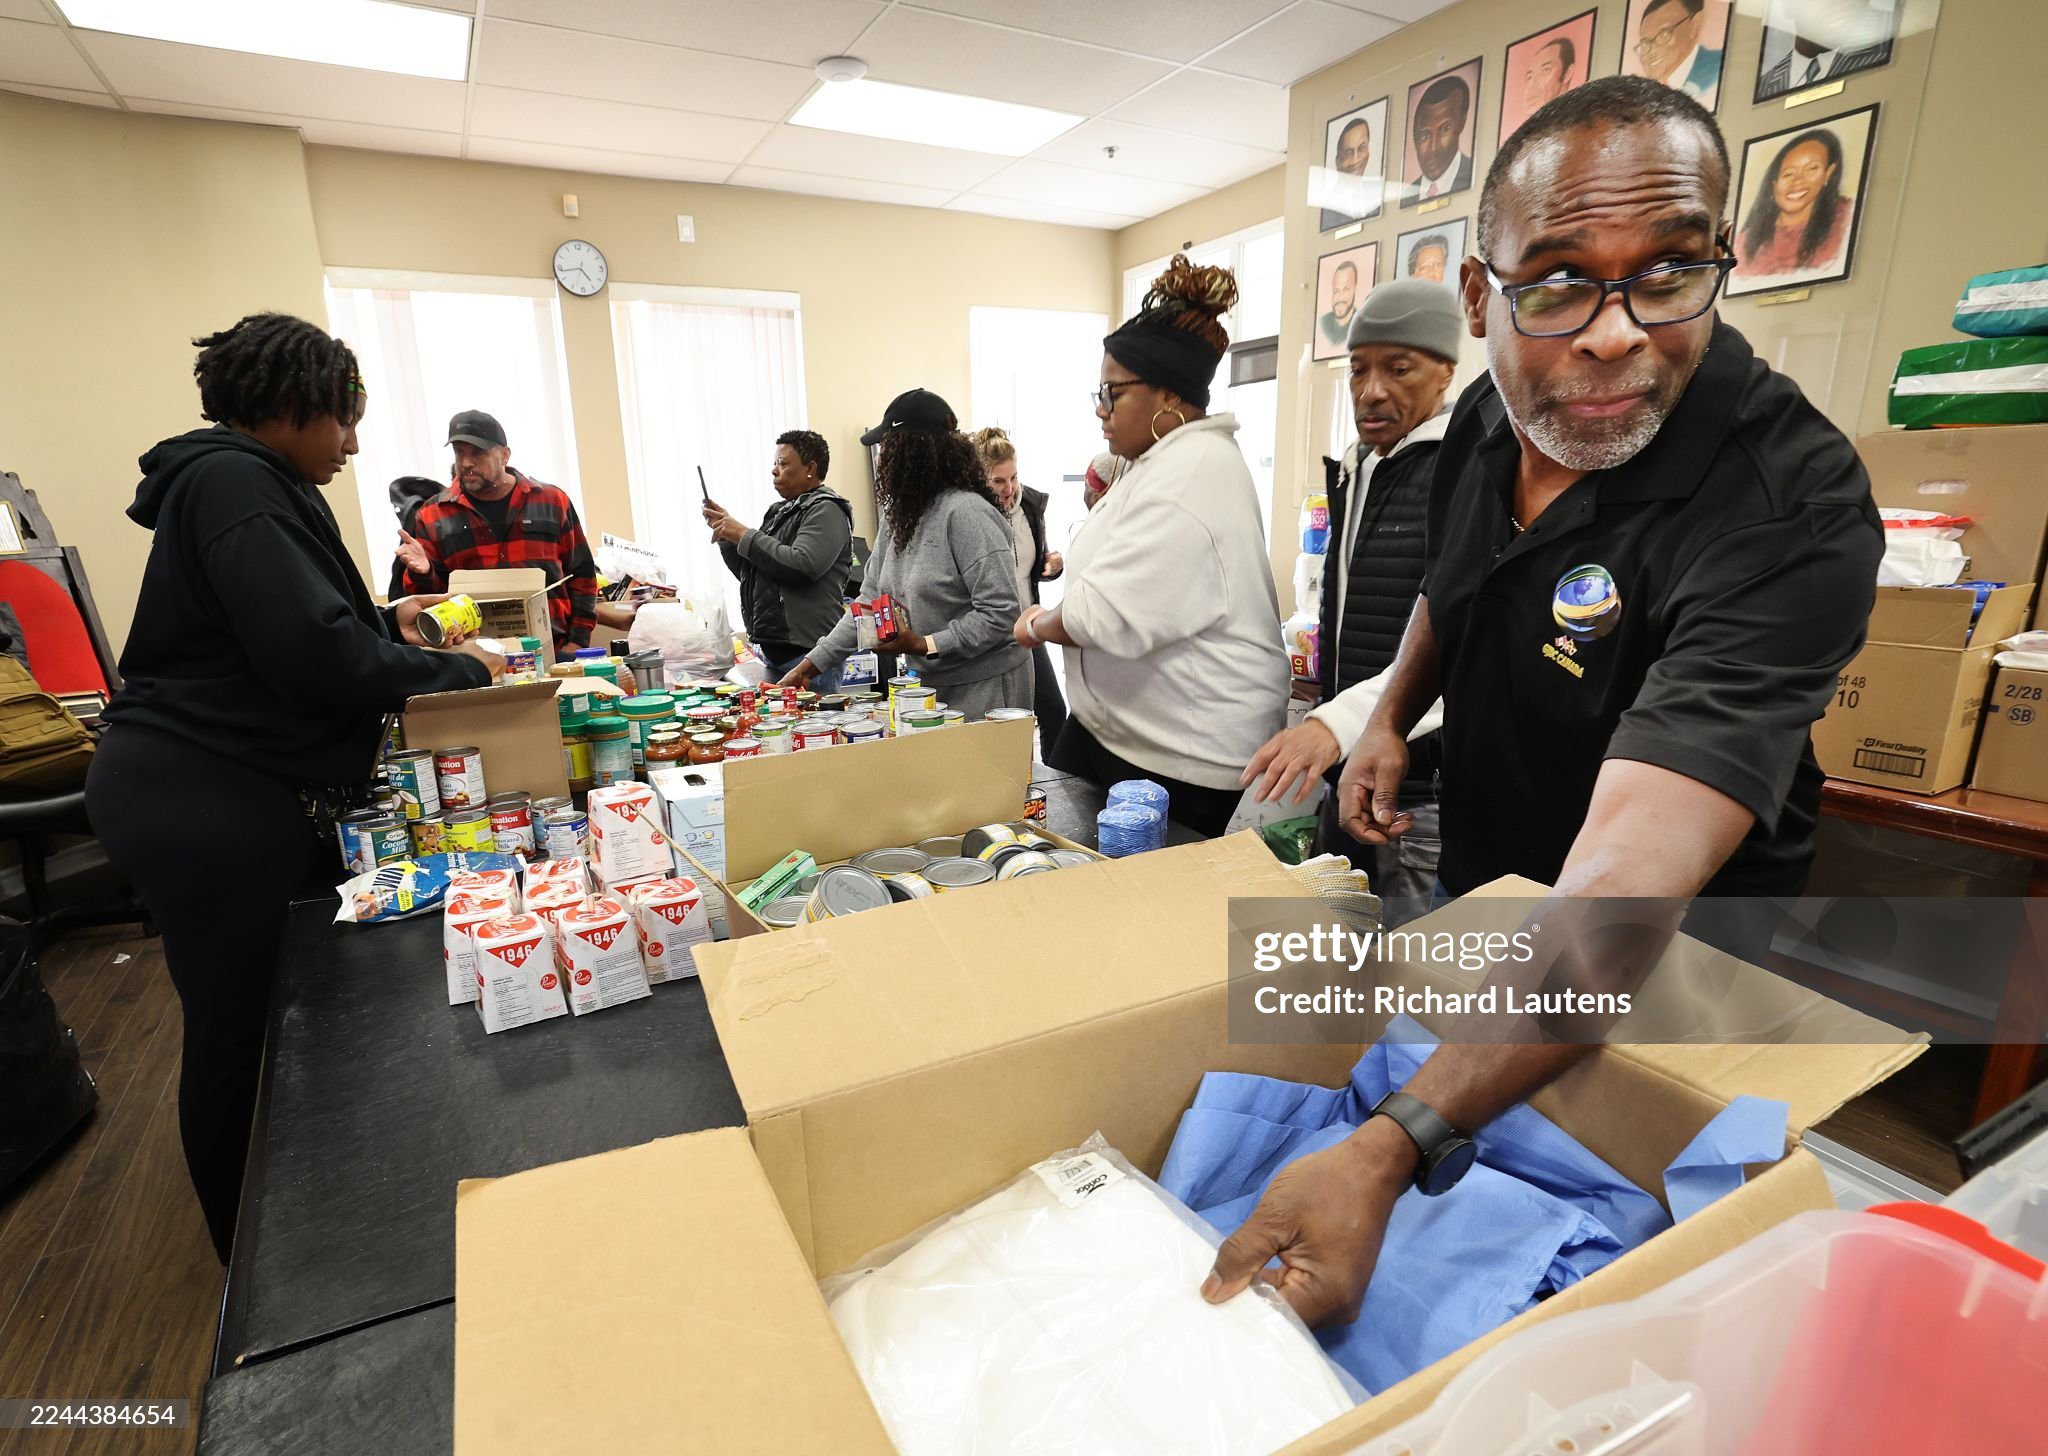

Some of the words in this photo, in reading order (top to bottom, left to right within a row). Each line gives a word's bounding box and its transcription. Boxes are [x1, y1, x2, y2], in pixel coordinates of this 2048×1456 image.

[1294, 657, 1303, 674] 40
[1851, 676, 1866, 689] 48
[2004, 684, 2043, 701] 2/28
[2010, 707, 2032, 722] SB
[660, 904, 692, 920] 1946
[586, 927, 619, 945] 1946
[498, 943, 533, 962] 1946
